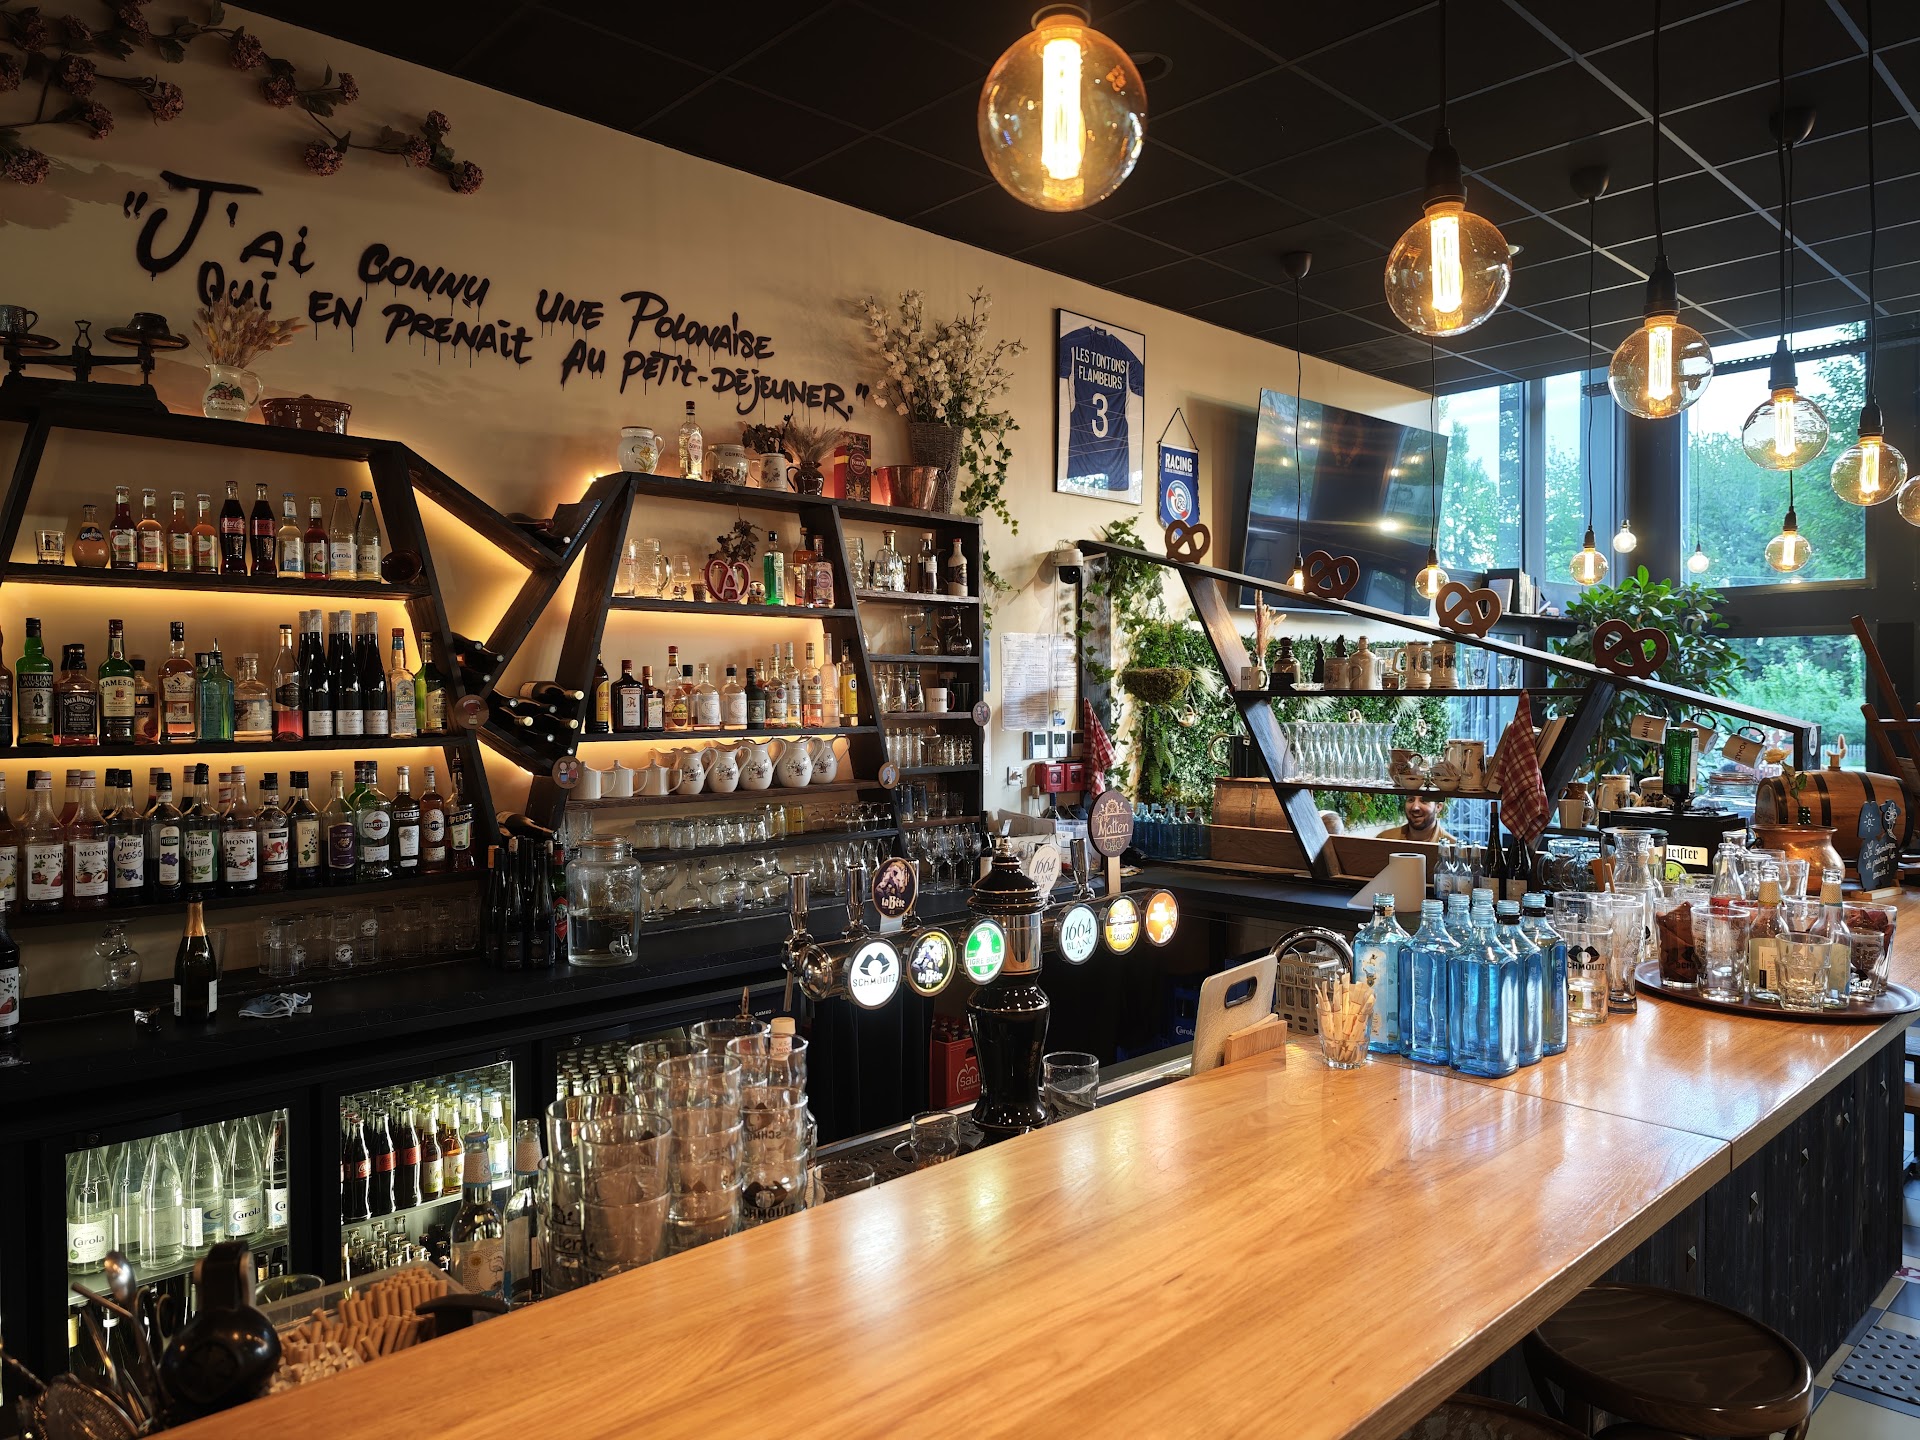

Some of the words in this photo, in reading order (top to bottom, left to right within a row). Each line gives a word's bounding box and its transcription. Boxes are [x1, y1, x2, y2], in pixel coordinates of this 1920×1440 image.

[359, 243, 490, 312] CONNU
[537, 289, 604, 333] UNE
[308, 292, 363, 328] EN
[561, 339, 605, 387] AU
[1076, 346, 1090, 363] LES
[1091, 351, 1126, 374] TONTONS
[1078, 365, 1123, 389] FLAMBEURS
[1092, 392, 1109, 437] 3
[1165, 453, 1193, 473] RACING
[101, 680, 135, 690] JAMESON
[1034, 856, 1057, 875] 1664
[1033, 874, 1055, 884] BLANC
[1065, 918, 1093, 941] 1664
[1113, 932, 1134, 942] SAISON
[1066, 935, 1094, 951] BLANC
[966, 957, 984, 967] TIGRE
[1567, 962, 1605, 971] CHMOUTZ
[852, 973, 896, 988] SCHMOUTZ
[232, 1206, 262, 1222] Carola
[74, 1234, 106, 1249] Carola
